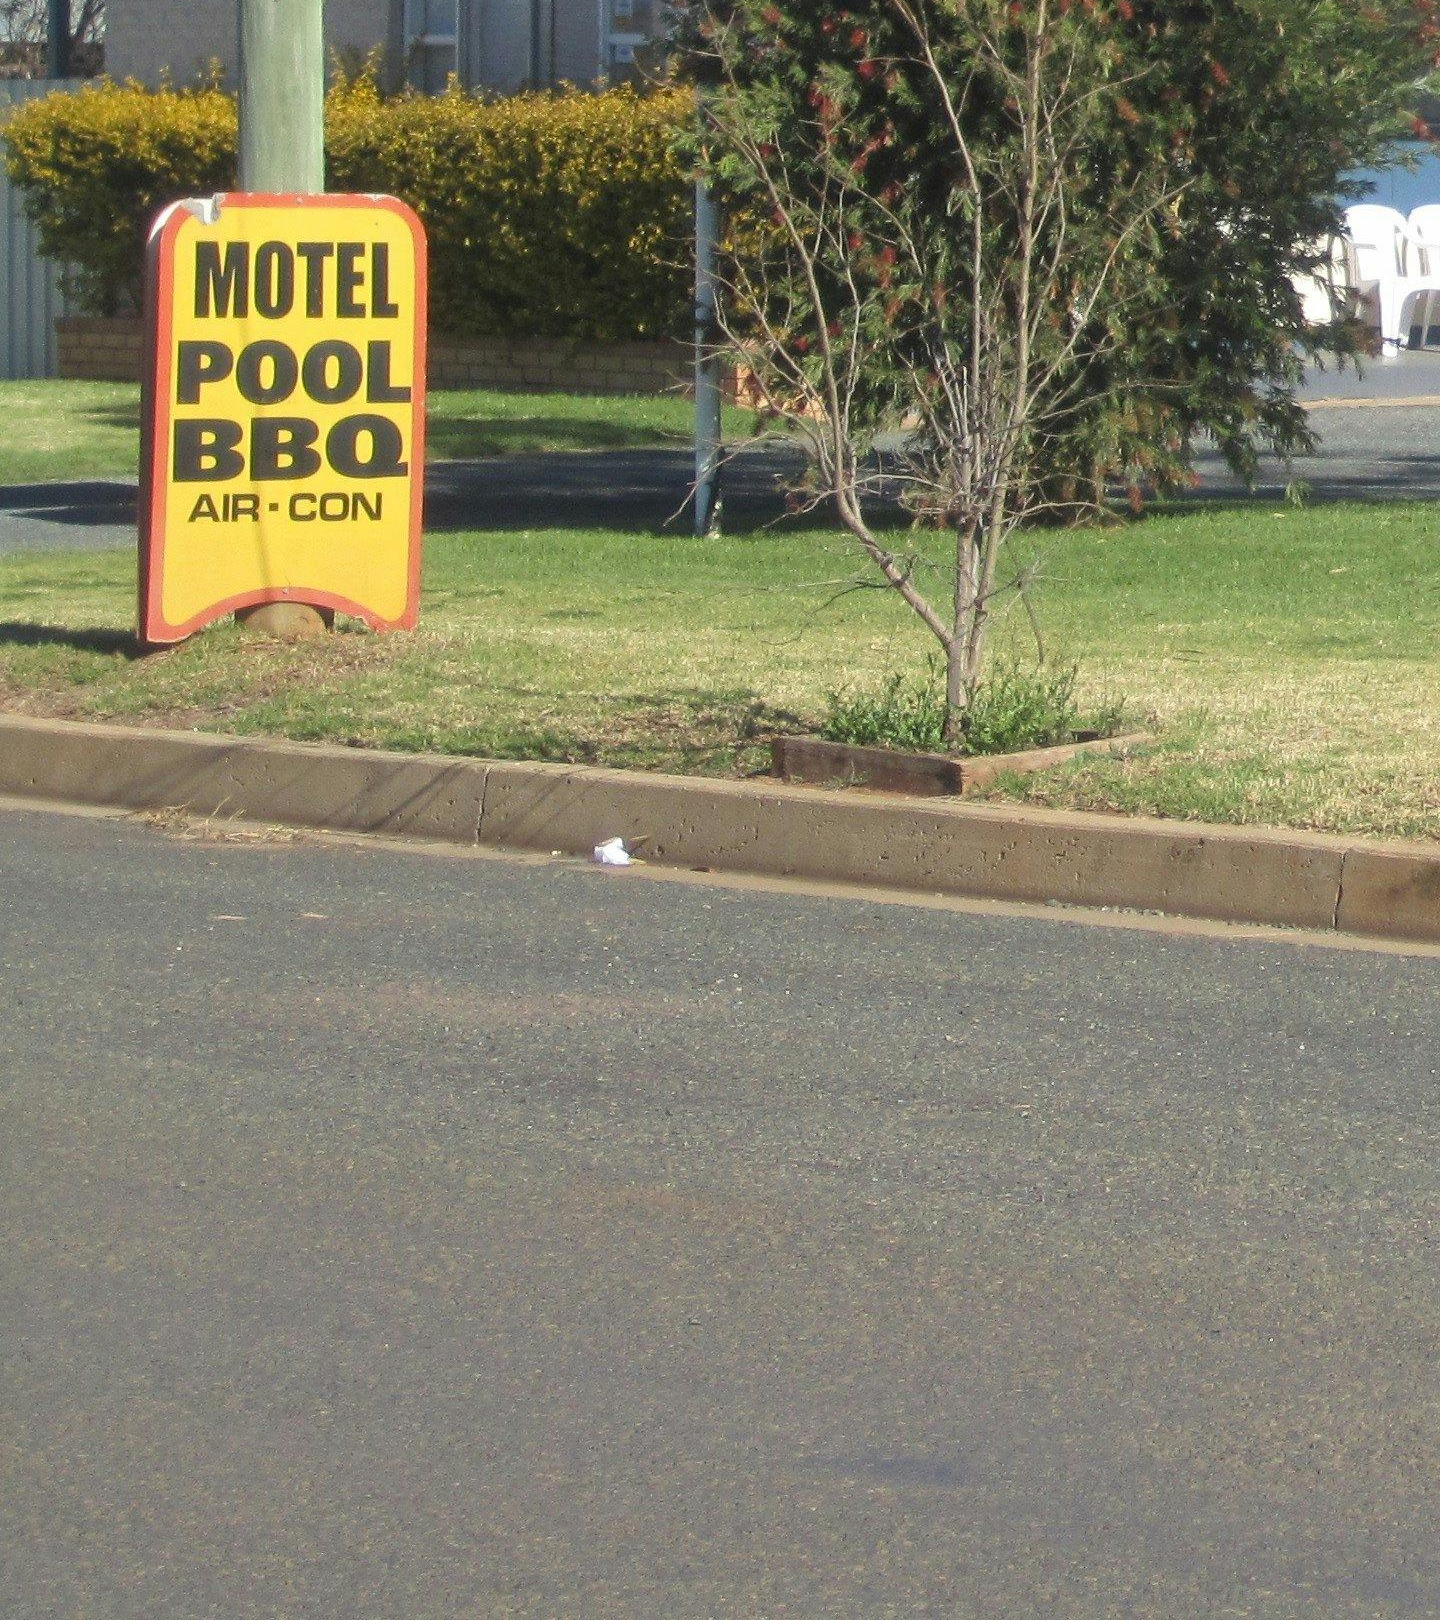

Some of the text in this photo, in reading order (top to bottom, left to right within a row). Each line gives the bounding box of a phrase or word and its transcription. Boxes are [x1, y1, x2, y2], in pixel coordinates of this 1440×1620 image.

[193, 241, 399, 320] MOTEL
[176, 339, 412, 406] POOL
[172, 414, 408, 483] BBQ
